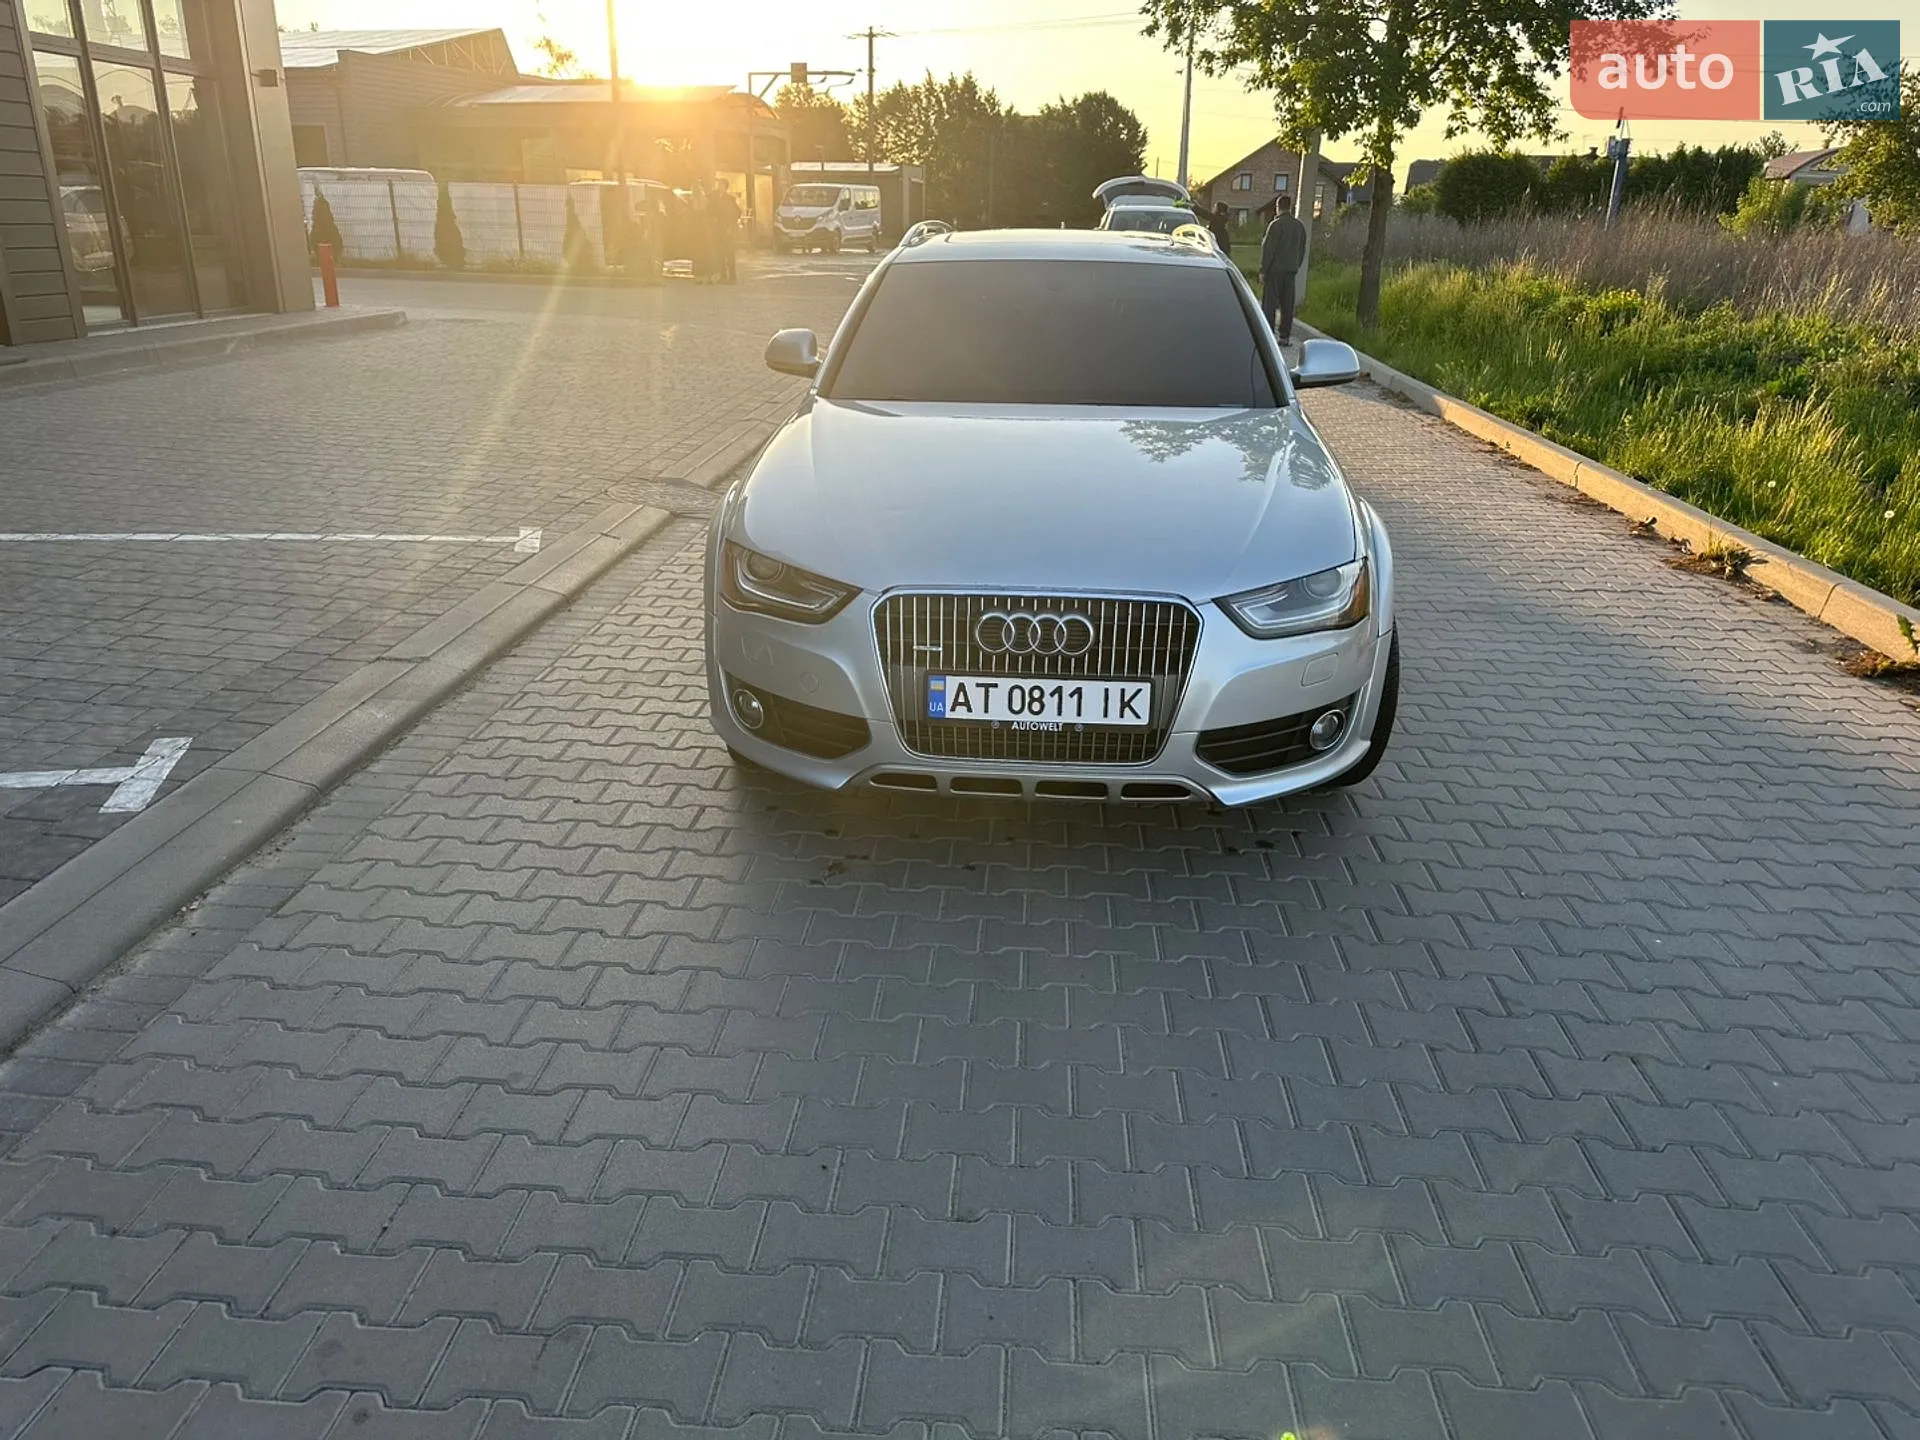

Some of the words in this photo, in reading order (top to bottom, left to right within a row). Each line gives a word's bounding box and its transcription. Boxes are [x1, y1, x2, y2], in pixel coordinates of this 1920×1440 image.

[949, 682, 998, 714] AT
[1007, 684, 1083, 717] 0811
[1102, 687, 1143, 720] IK
[929, 702, 944, 712] UA
[1011, 721, 1064, 732] AUTOWELT
